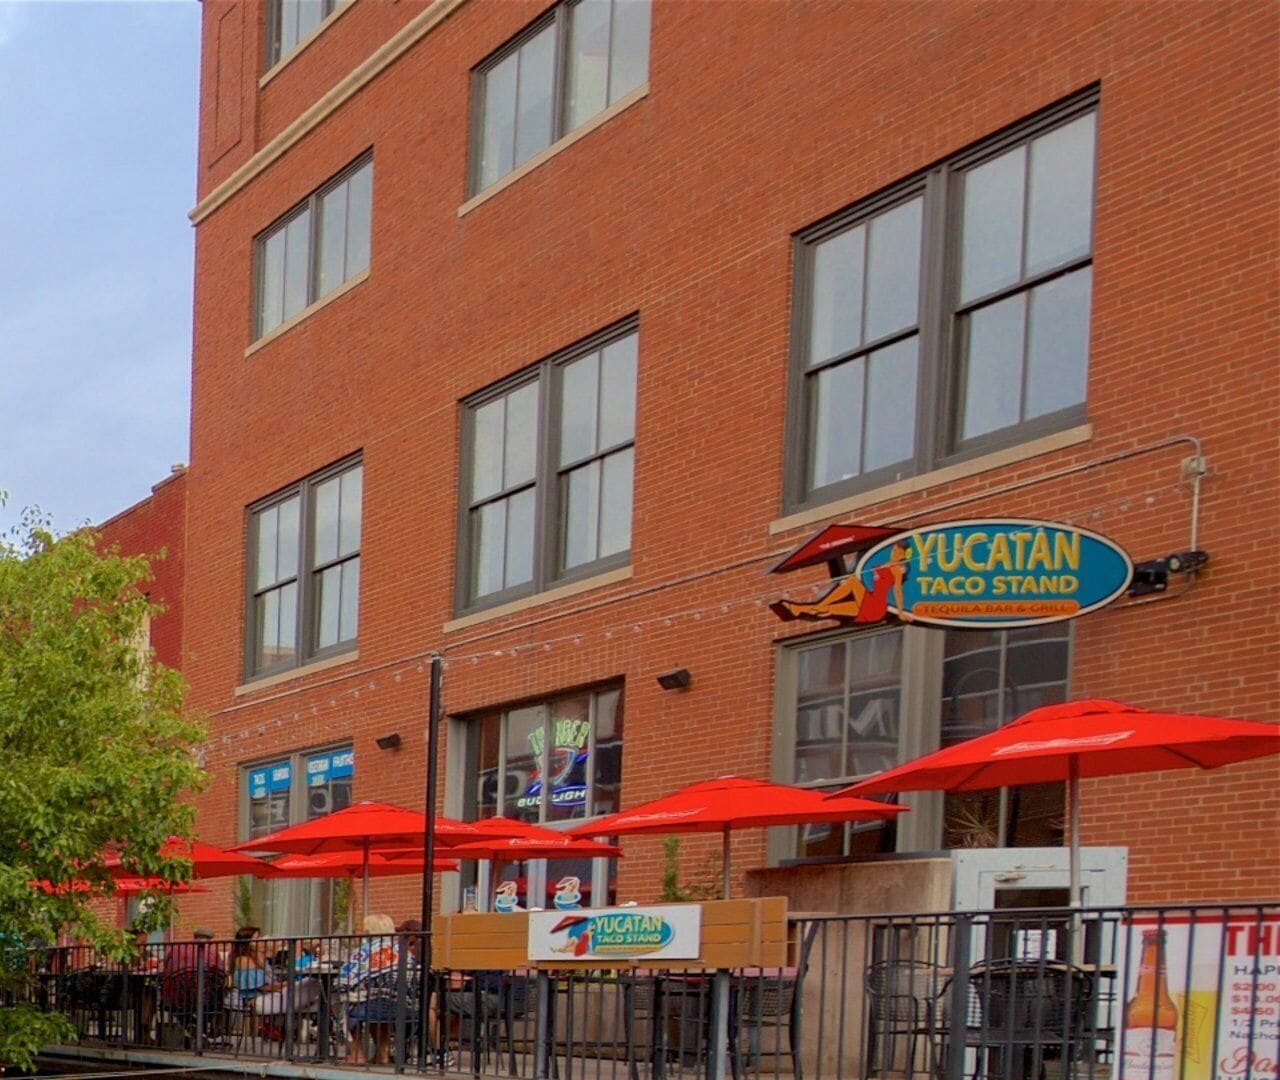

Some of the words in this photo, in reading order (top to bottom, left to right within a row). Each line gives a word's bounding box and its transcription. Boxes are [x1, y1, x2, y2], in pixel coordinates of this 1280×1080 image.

[912, 531, 1080, 572] YUCATAN
[916, 576, 986, 595] TACO
[991, 575, 1079, 595] STAND
[924, 603, 981, 614] TEQUILA
[985, 603, 1013, 613] BAR
[1029, 603, 1068, 613] GRILL
[551, 790, 586, 802] LIGH
[595, 915, 664, 935] YUCATAN
[597, 935, 623, 944] TACO
[626, 934, 663, 943] STAND
